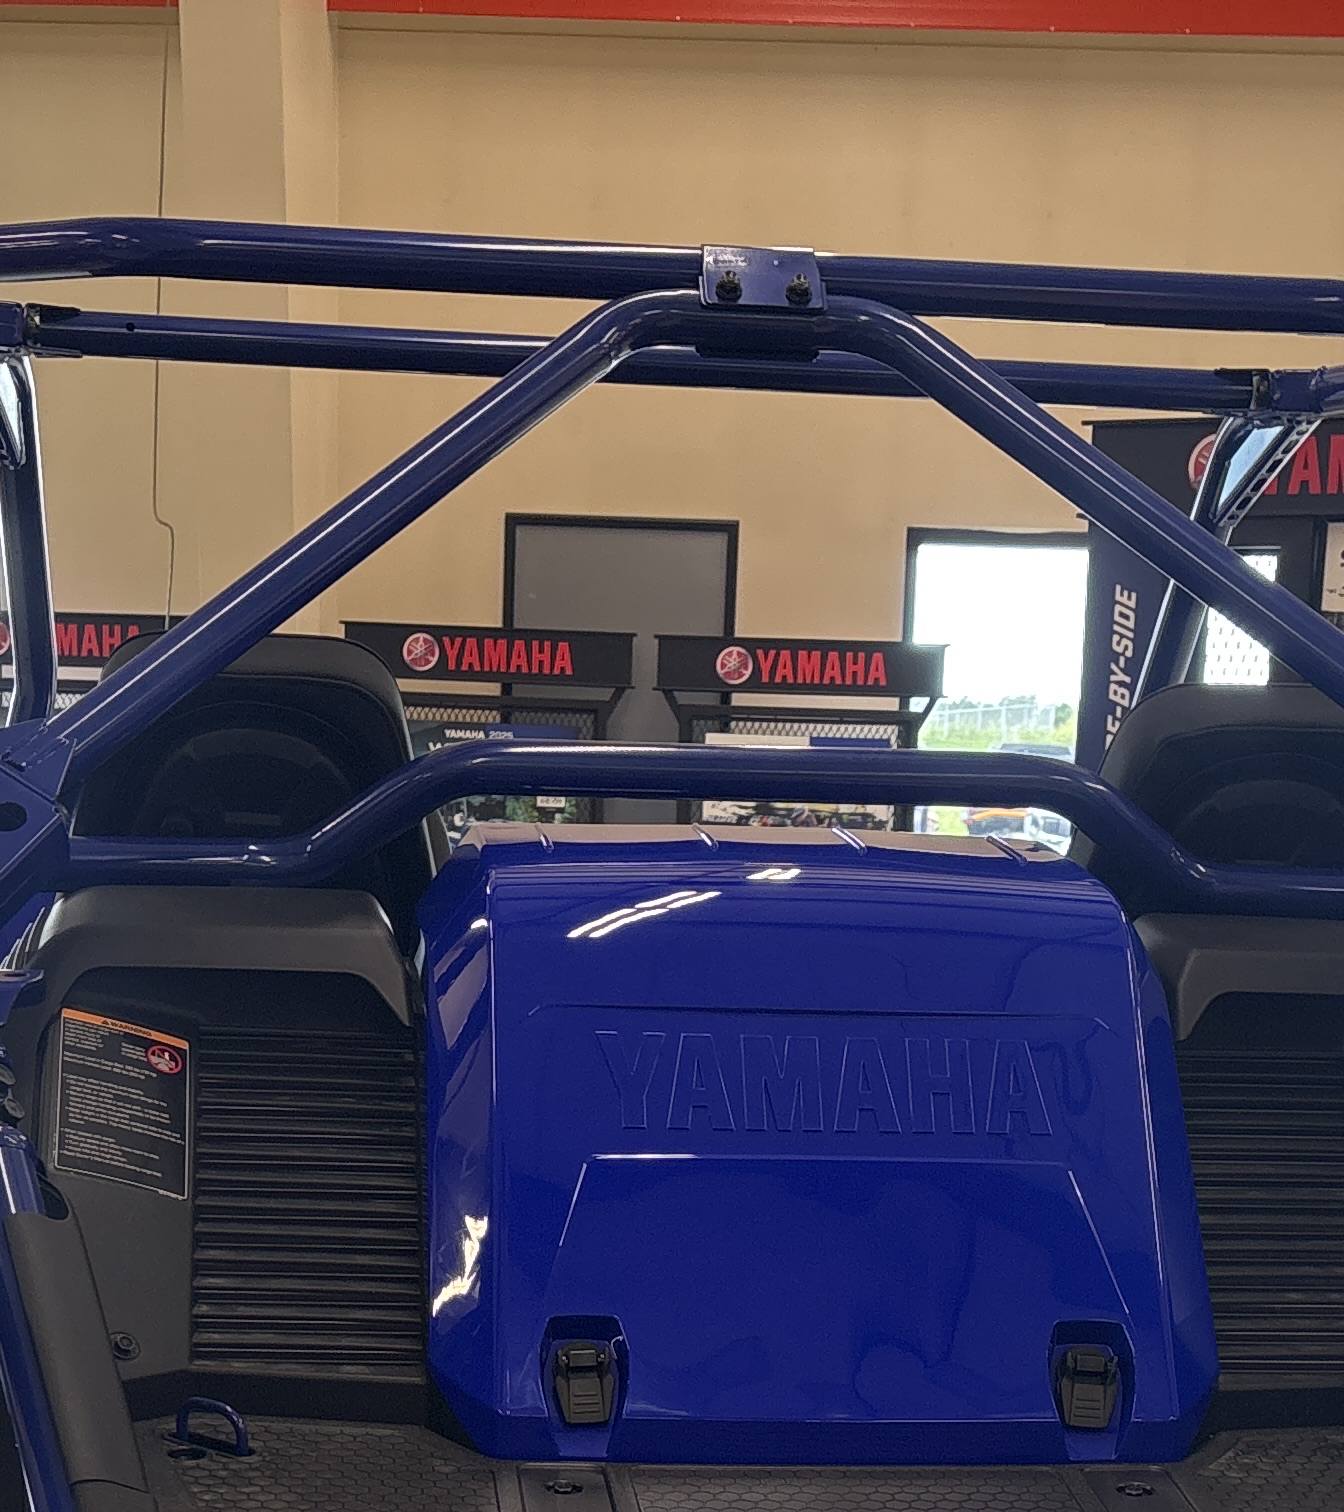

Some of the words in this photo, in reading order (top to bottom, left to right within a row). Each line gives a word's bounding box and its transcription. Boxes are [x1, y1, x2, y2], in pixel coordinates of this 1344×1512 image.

[56, 623, 140, 658] MAH
[442, 635, 573, 675] YAMAHA
[757, 648, 887, 686] YAMAHA
[1105, 584, 1137, 750] E-BY-SIDE
[444, 729, 485, 740] YAMAHA
[594, 1030, 1053, 1135] YAMAHA
